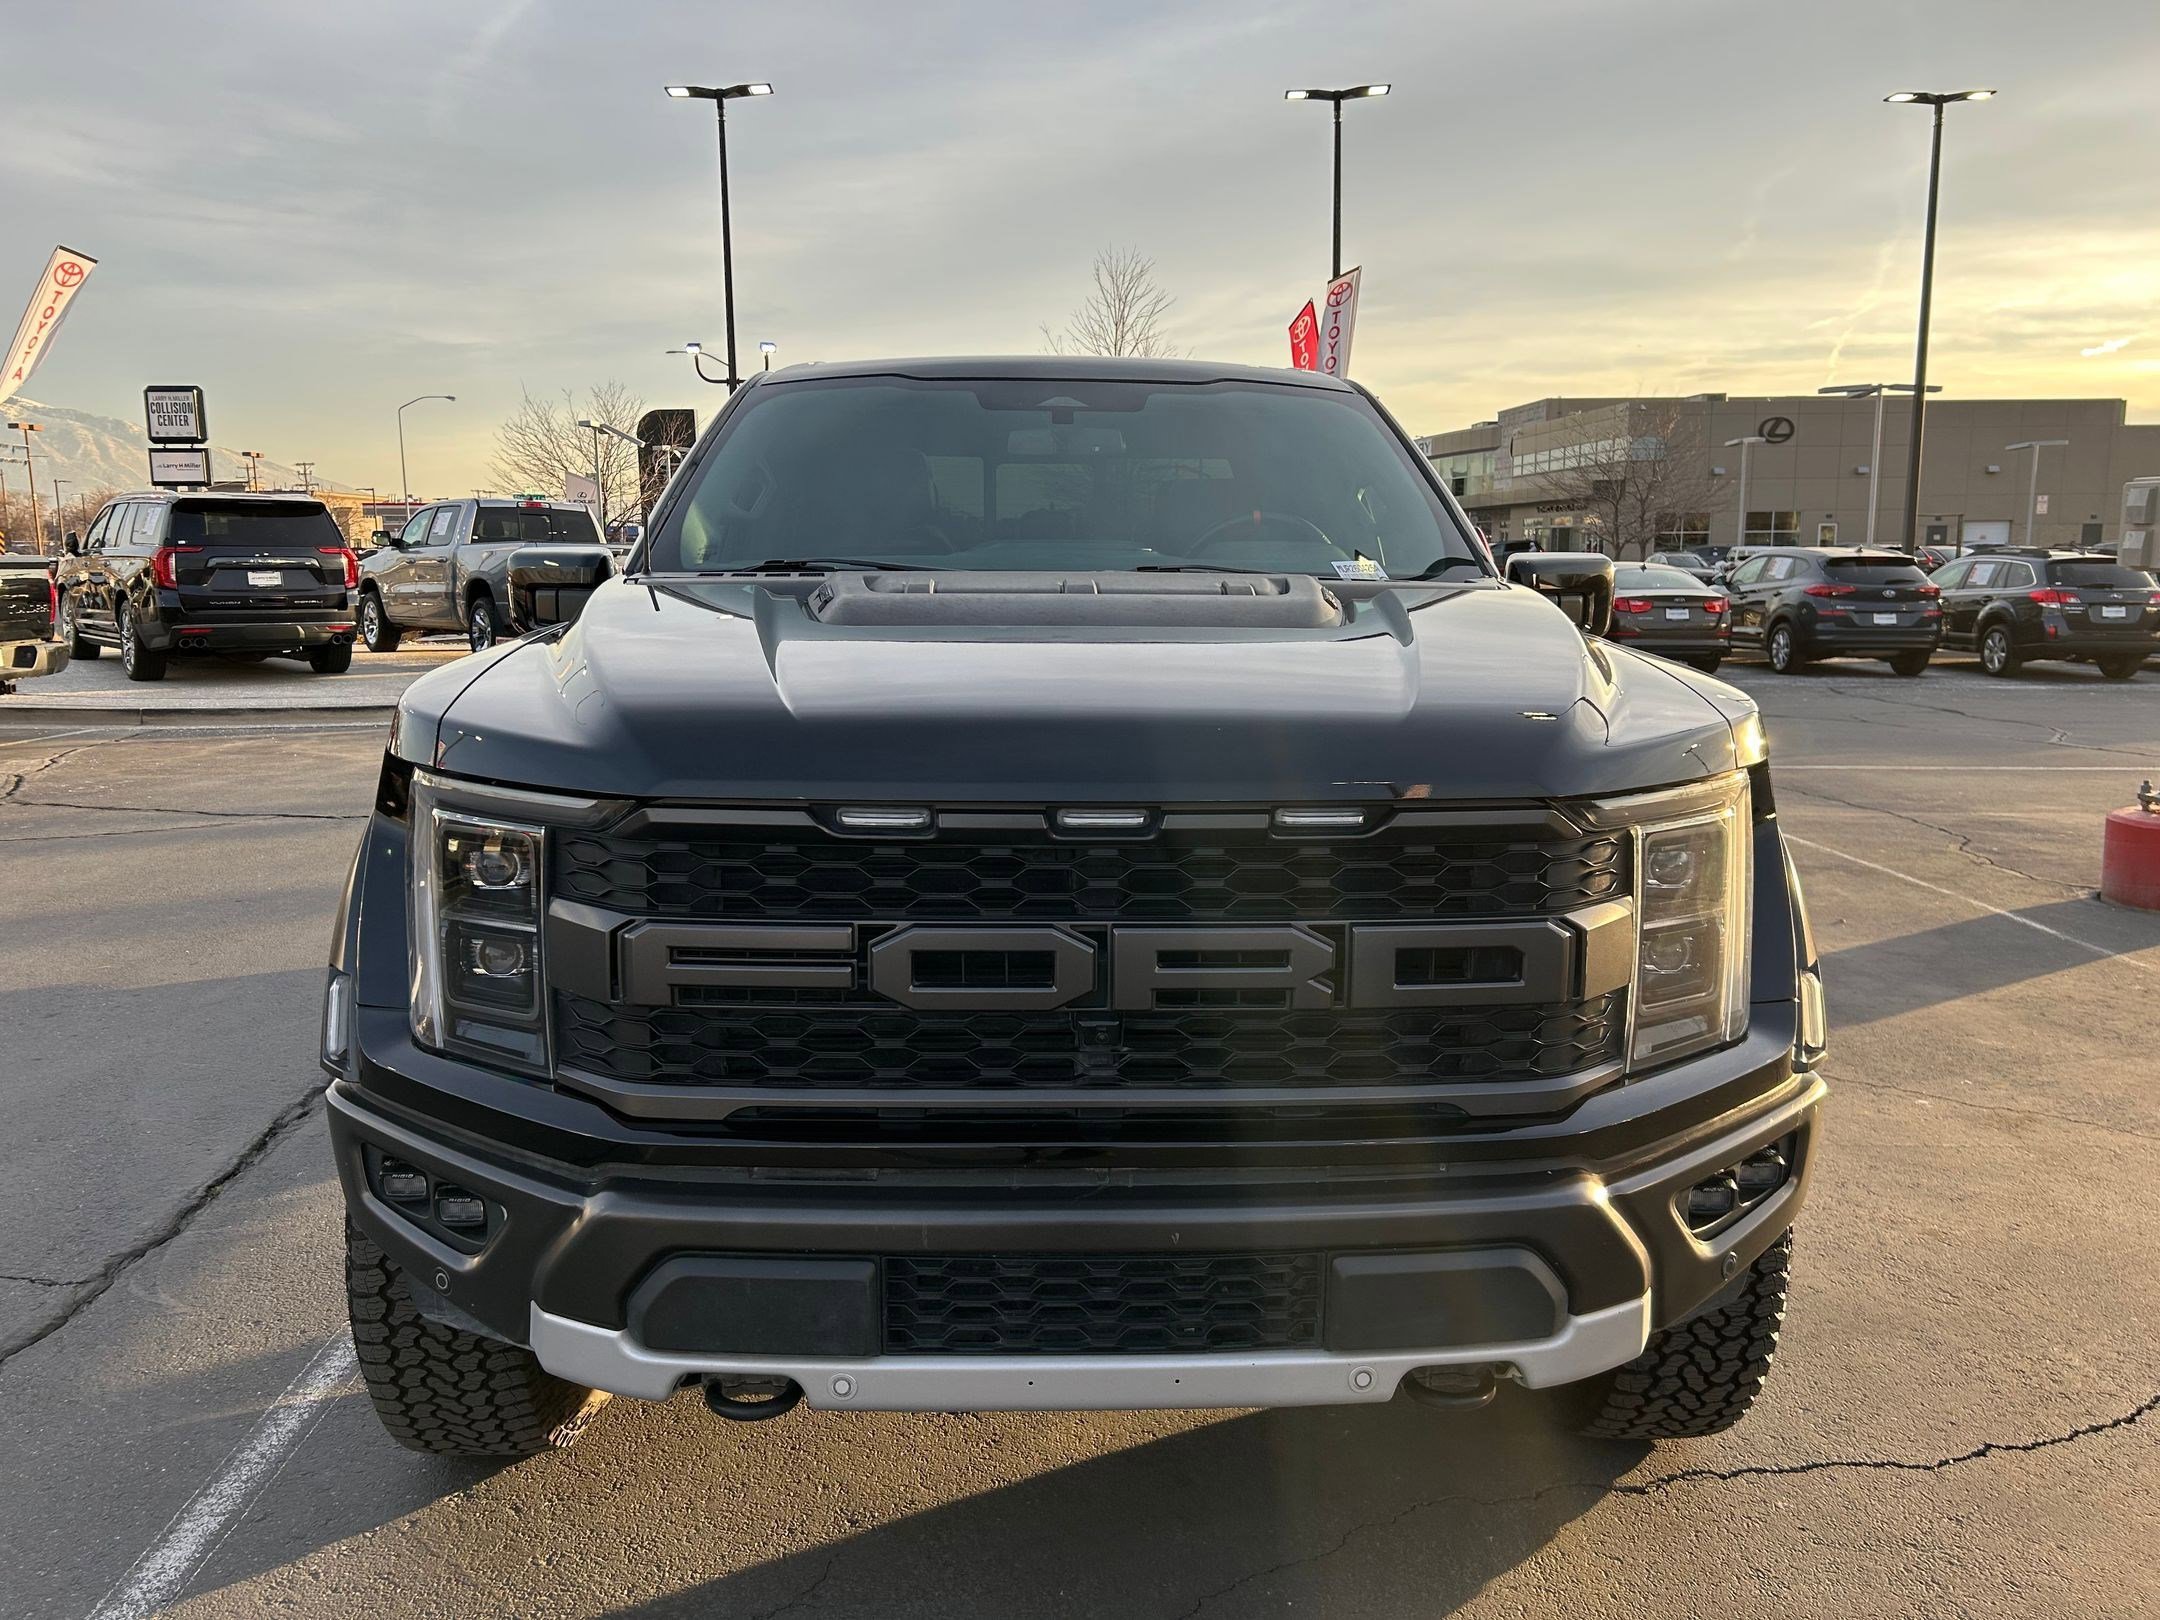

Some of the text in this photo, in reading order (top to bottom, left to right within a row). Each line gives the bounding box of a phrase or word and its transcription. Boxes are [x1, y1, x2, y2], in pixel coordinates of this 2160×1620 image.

[12, 290, 63, 380] TOYOTA
[1325, 310, 1342, 375] TOYO
[151, 402, 193, 414] COLLISION
[157, 415, 189, 426] CENTER
[619, 920, 1574, 1011] FORD
